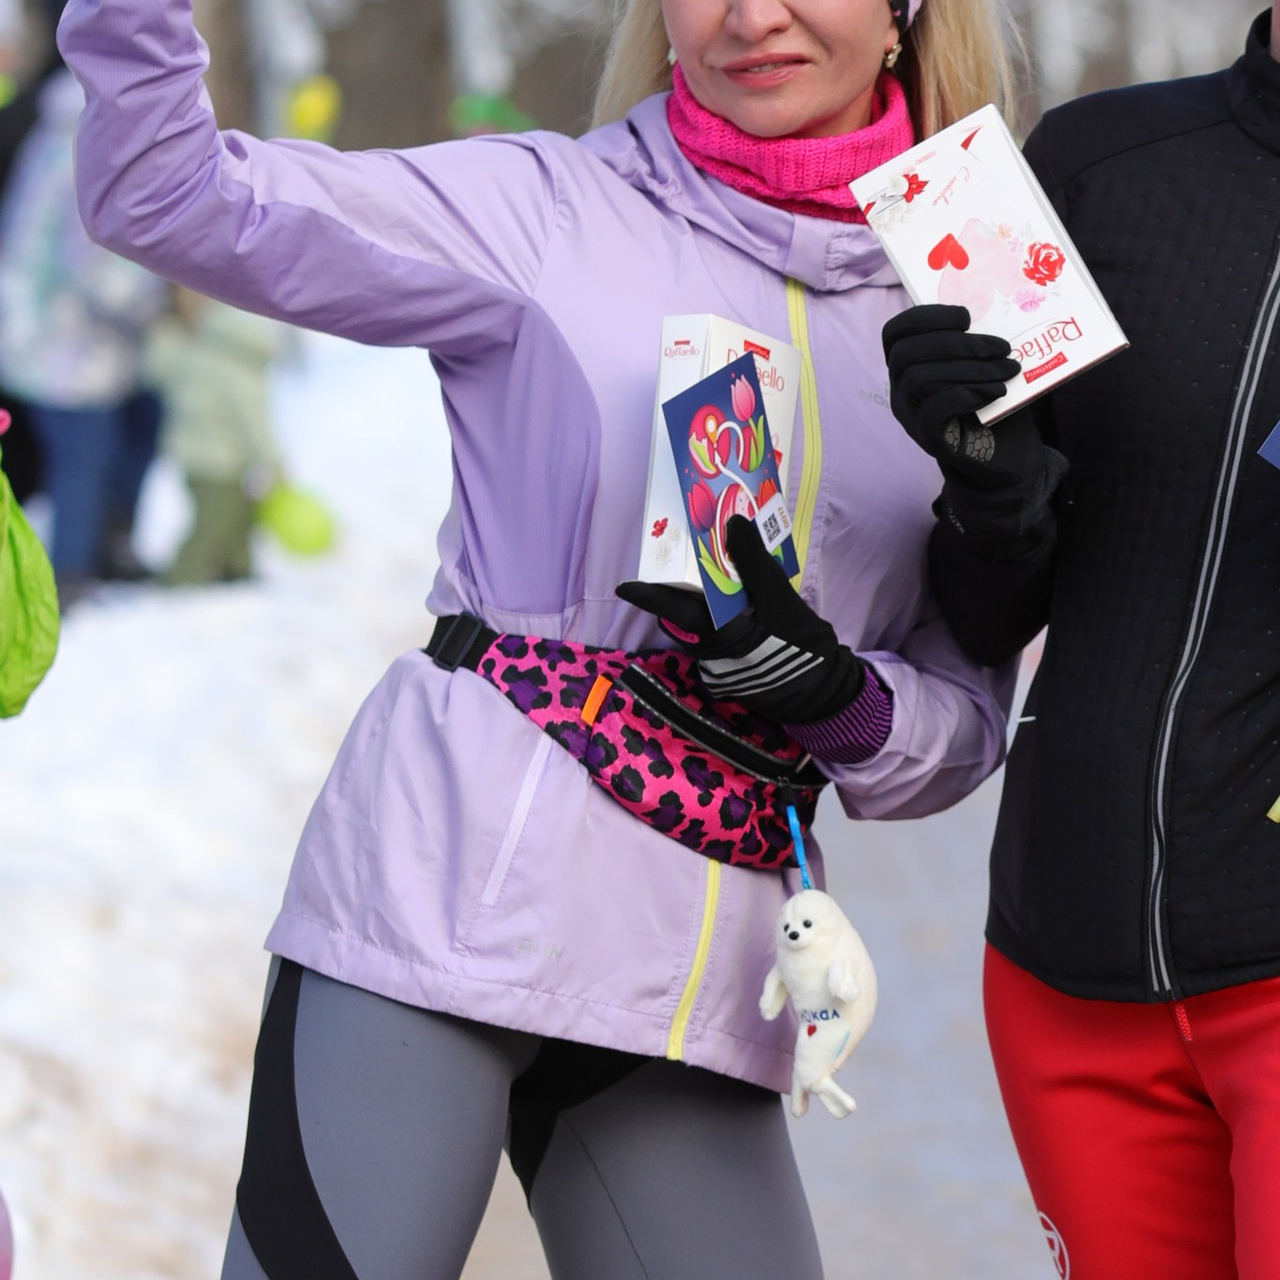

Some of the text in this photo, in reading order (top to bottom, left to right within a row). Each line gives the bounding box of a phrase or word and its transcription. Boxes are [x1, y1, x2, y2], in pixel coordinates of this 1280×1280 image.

[664, 344, 700, 358] Raffaello
[1010, 316, 1083, 363] Raffae
[777, 505, 790, 530] 0017
